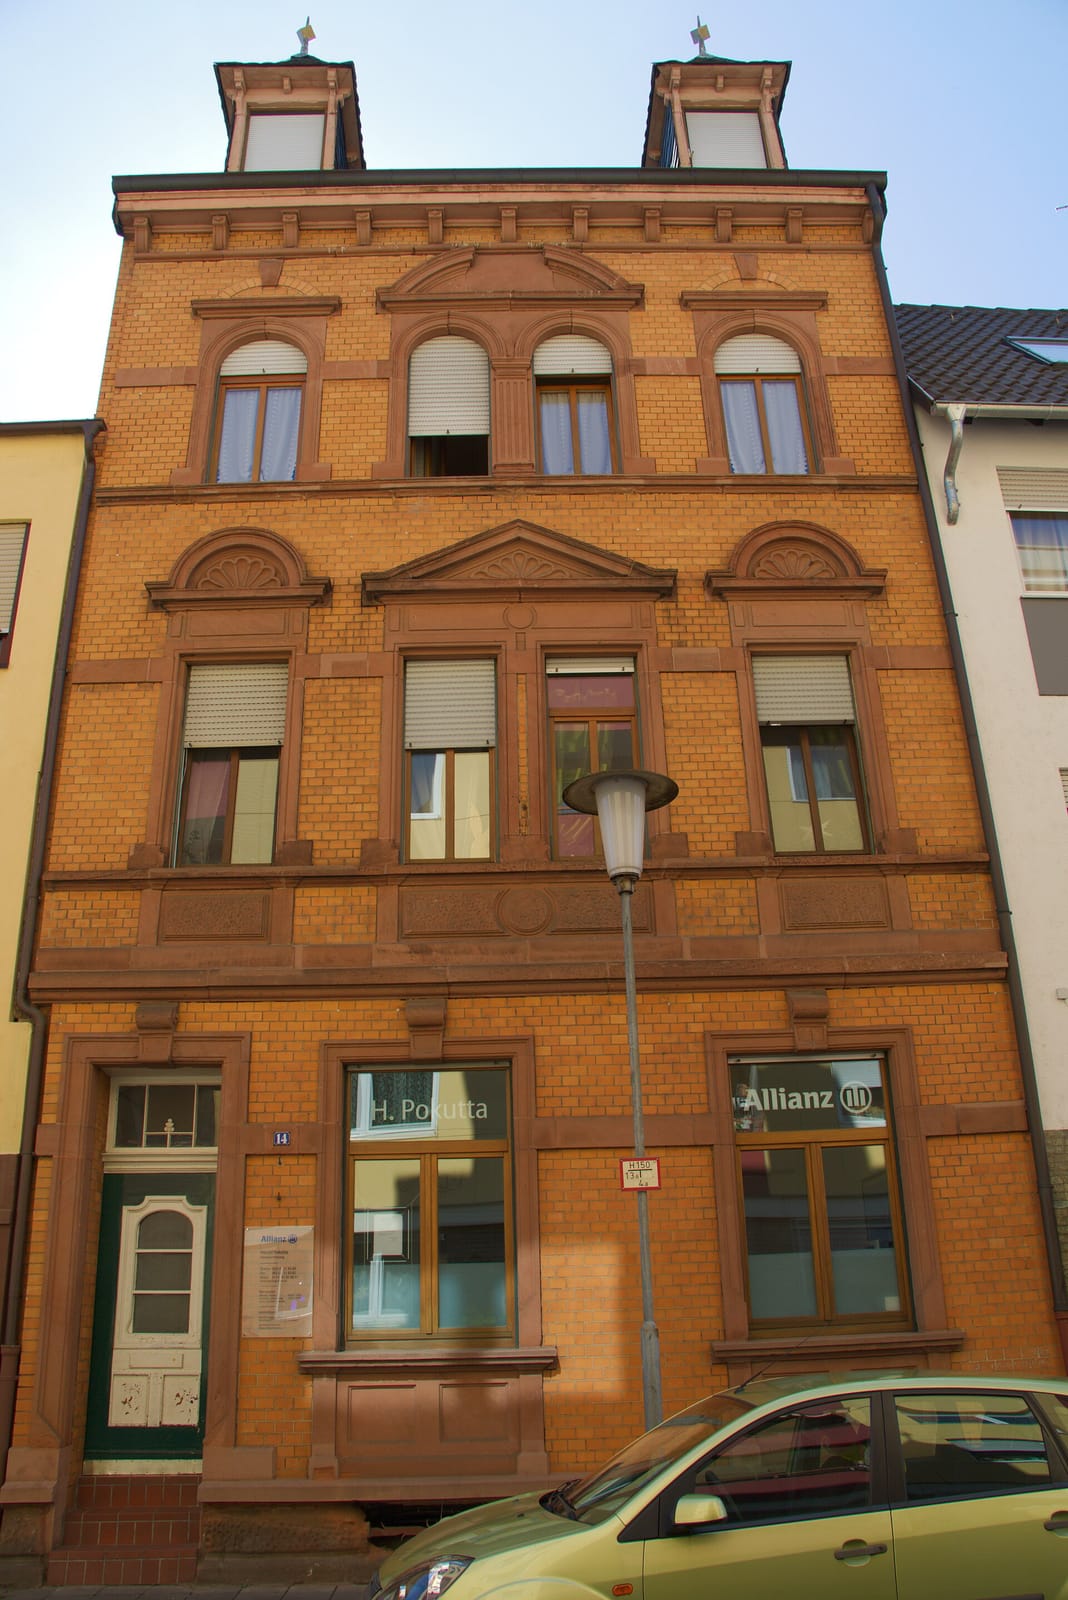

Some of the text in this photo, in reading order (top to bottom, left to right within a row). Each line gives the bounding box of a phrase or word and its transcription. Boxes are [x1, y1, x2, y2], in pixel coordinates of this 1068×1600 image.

[743, 1087, 835, 1111] Allianz
[371, 1098, 488, 1121] H. Pokutta
[276, 1133, 288, 1144] 14
[260, 1235, 287, 1243] Allianz
